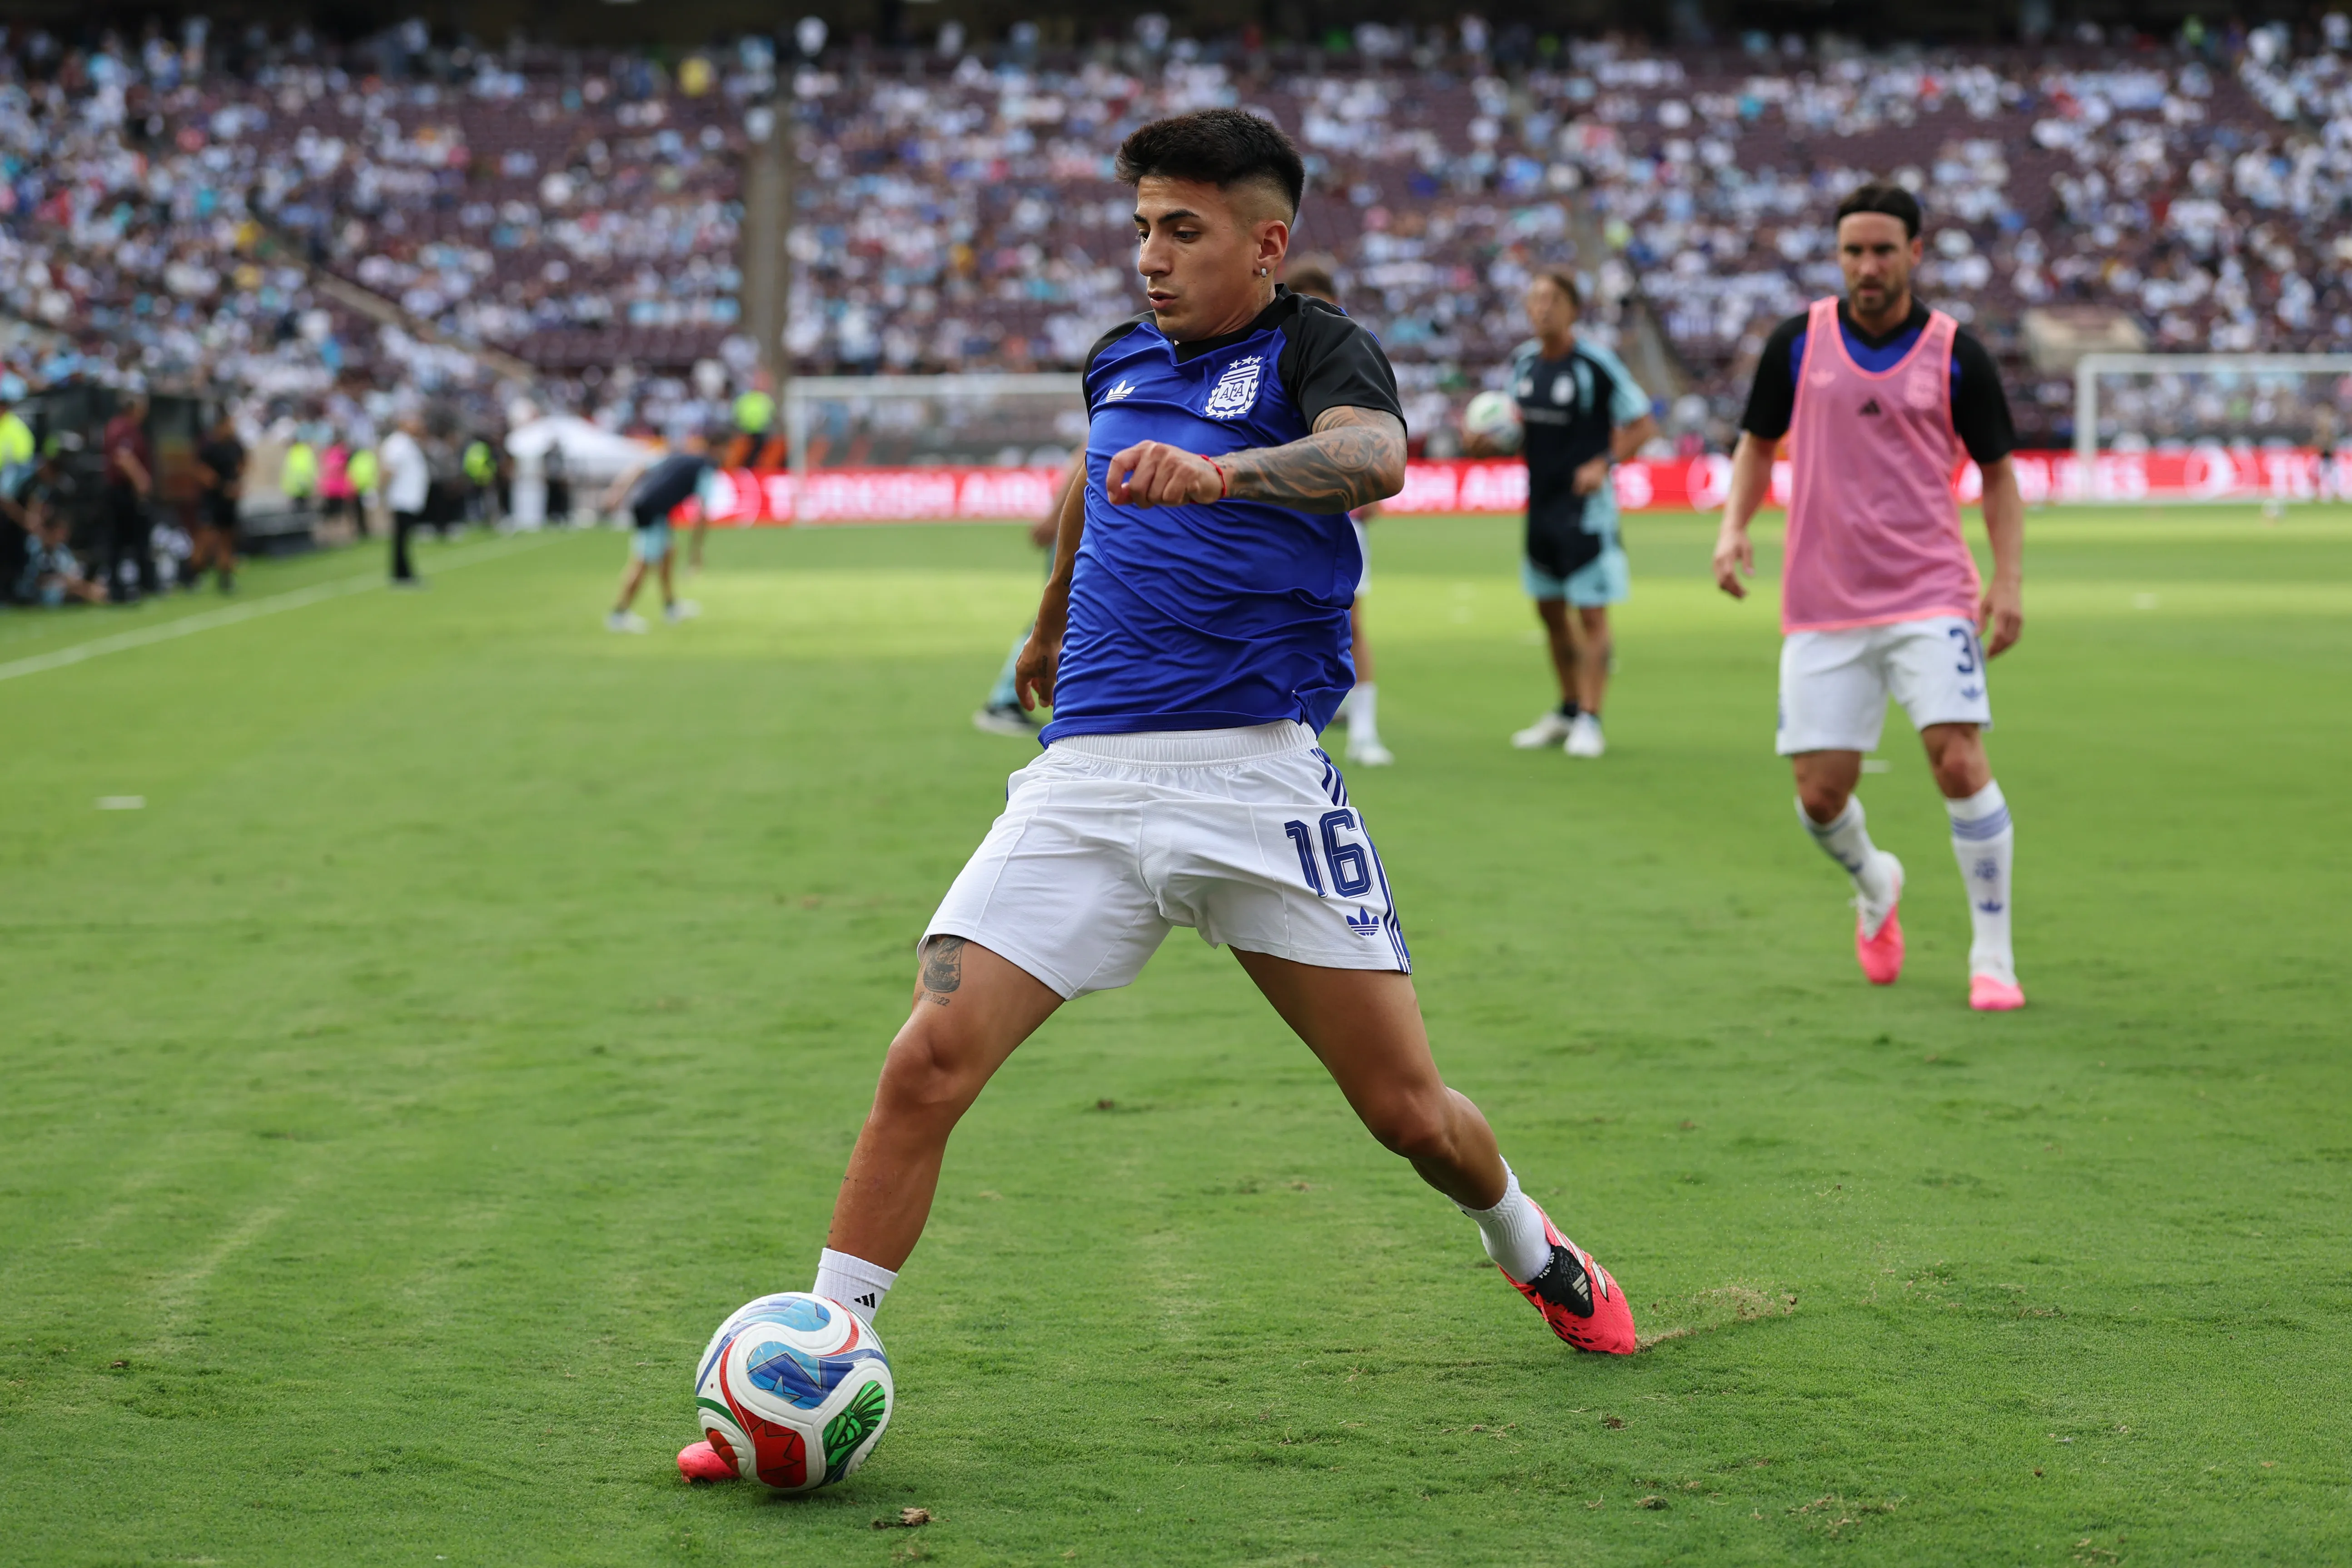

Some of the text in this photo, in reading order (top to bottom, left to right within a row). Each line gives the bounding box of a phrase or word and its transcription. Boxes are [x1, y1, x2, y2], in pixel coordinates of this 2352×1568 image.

[1219, 380, 1245, 402] AFA
[1949, 627, 1974, 674] 3
[1284, 808, 1373, 898] 16
[1538, 1266, 1551, 1279] 1994
